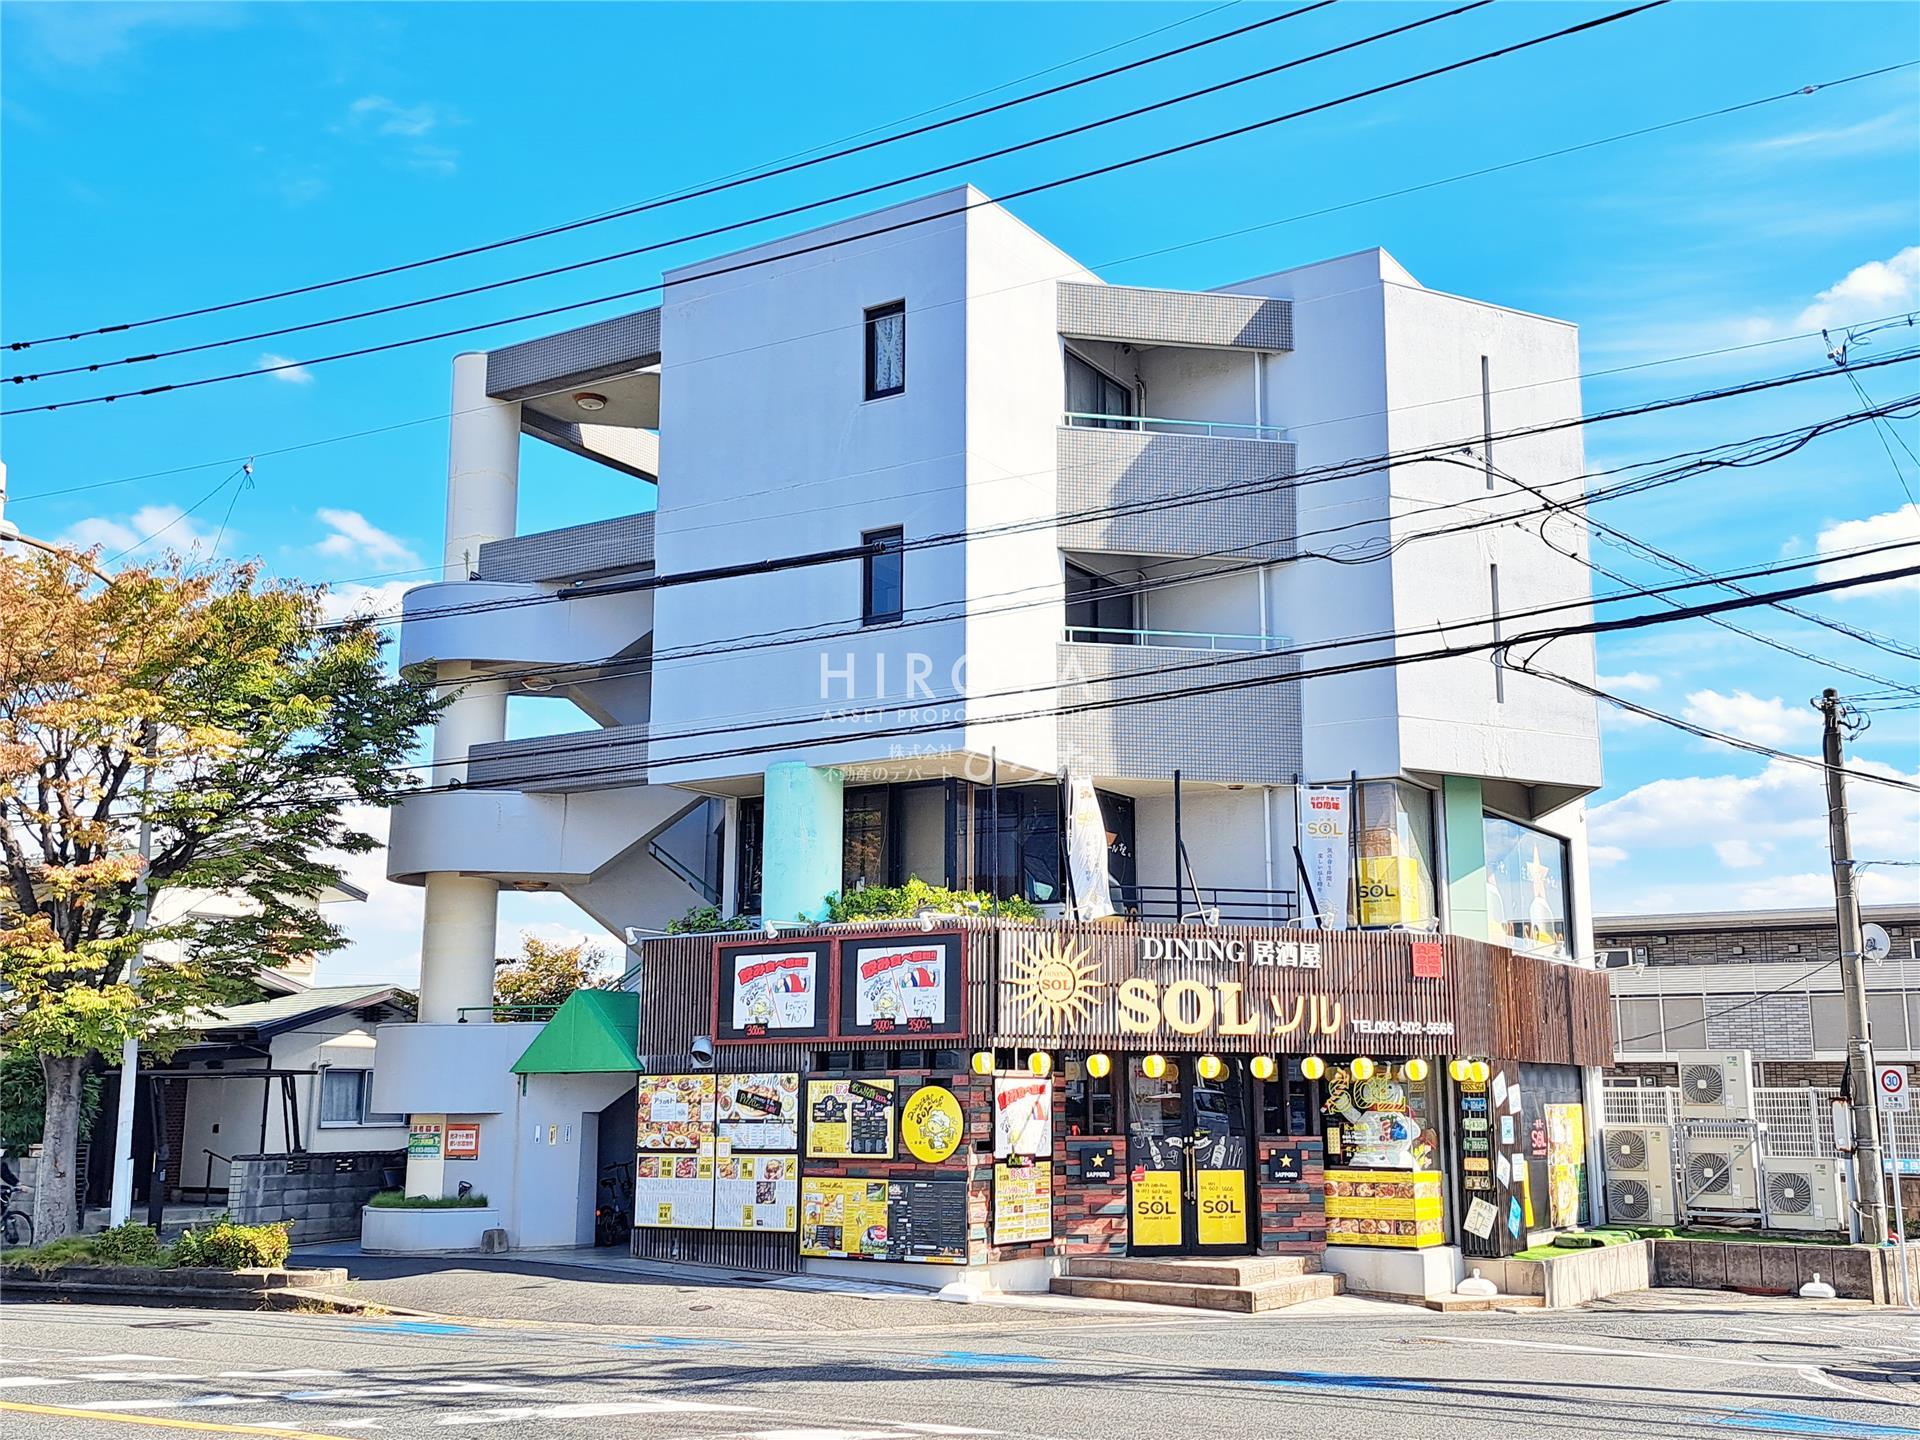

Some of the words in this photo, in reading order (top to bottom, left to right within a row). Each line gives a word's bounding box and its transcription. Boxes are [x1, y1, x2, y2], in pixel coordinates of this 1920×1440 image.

[1310, 801, 1341, 810] 10周年
[1306, 822, 1343, 835] SOL
[1359, 885, 1396, 898] SOL
[1142, 937, 1245, 962] DINING
[1249, 940, 1322, 968] 居酒屋
[1042, 979, 1071, 991] SOL
[1117, 977, 1260, 1035] SOL
[1271, 994, 1342, 1036] ソル
[1886, 1075, 1898, 1087] 30
[1137, 1201, 1177, 1215] SOL
[1203, 1200, 1242, 1214] SOL
